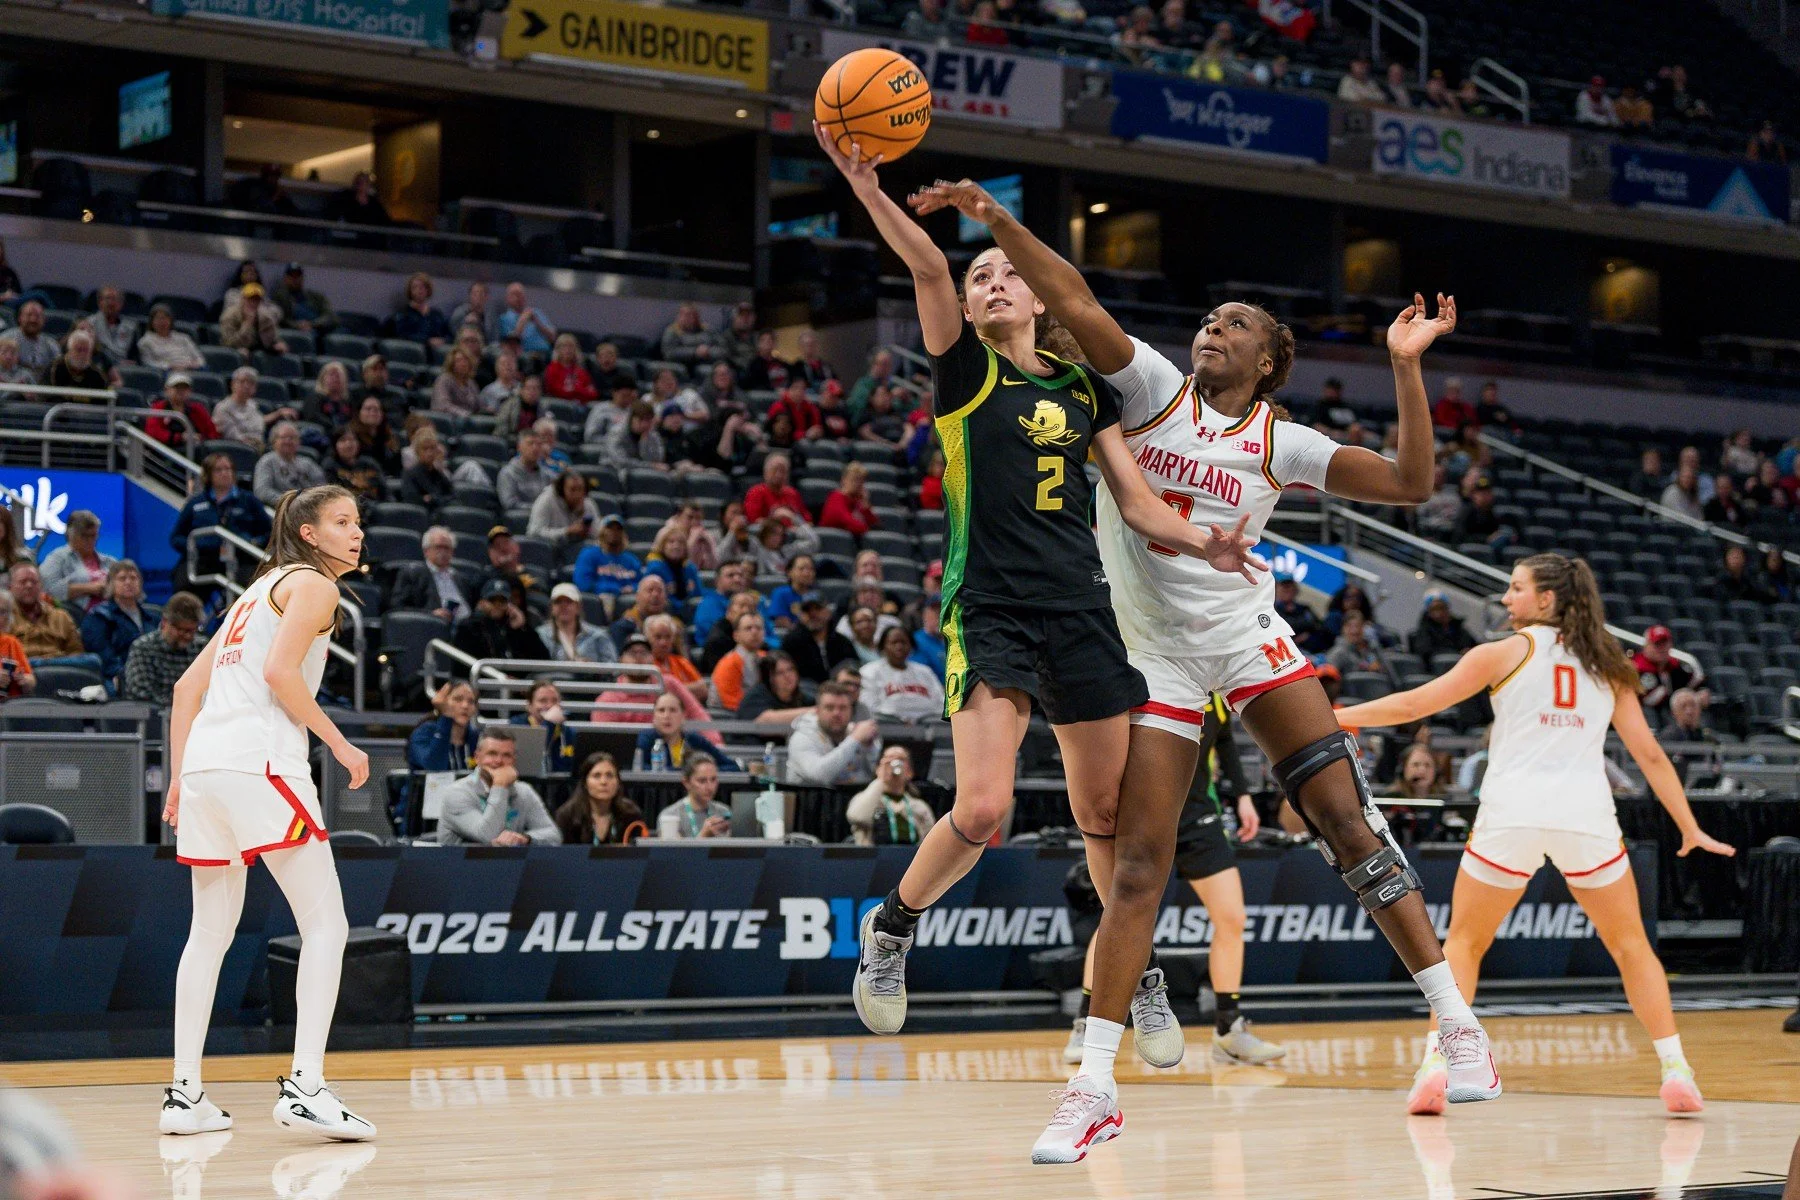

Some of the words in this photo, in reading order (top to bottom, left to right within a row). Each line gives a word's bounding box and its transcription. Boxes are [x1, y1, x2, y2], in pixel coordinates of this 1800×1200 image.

[559, 11, 755, 72] GAINBRIDGE
[1379, 119, 1465, 176] aes
[1473, 146, 1567, 193] Indiana
[1231, 439, 1261, 455] B1G
[1035, 456, 1064, 510] 2
[1137, 444, 1242, 508] MARYLAND
[223, 597, 258, 649] 12
[1553, 664, 1577, 709] 0
[518, 909, 769, 951] ALLSTATE
